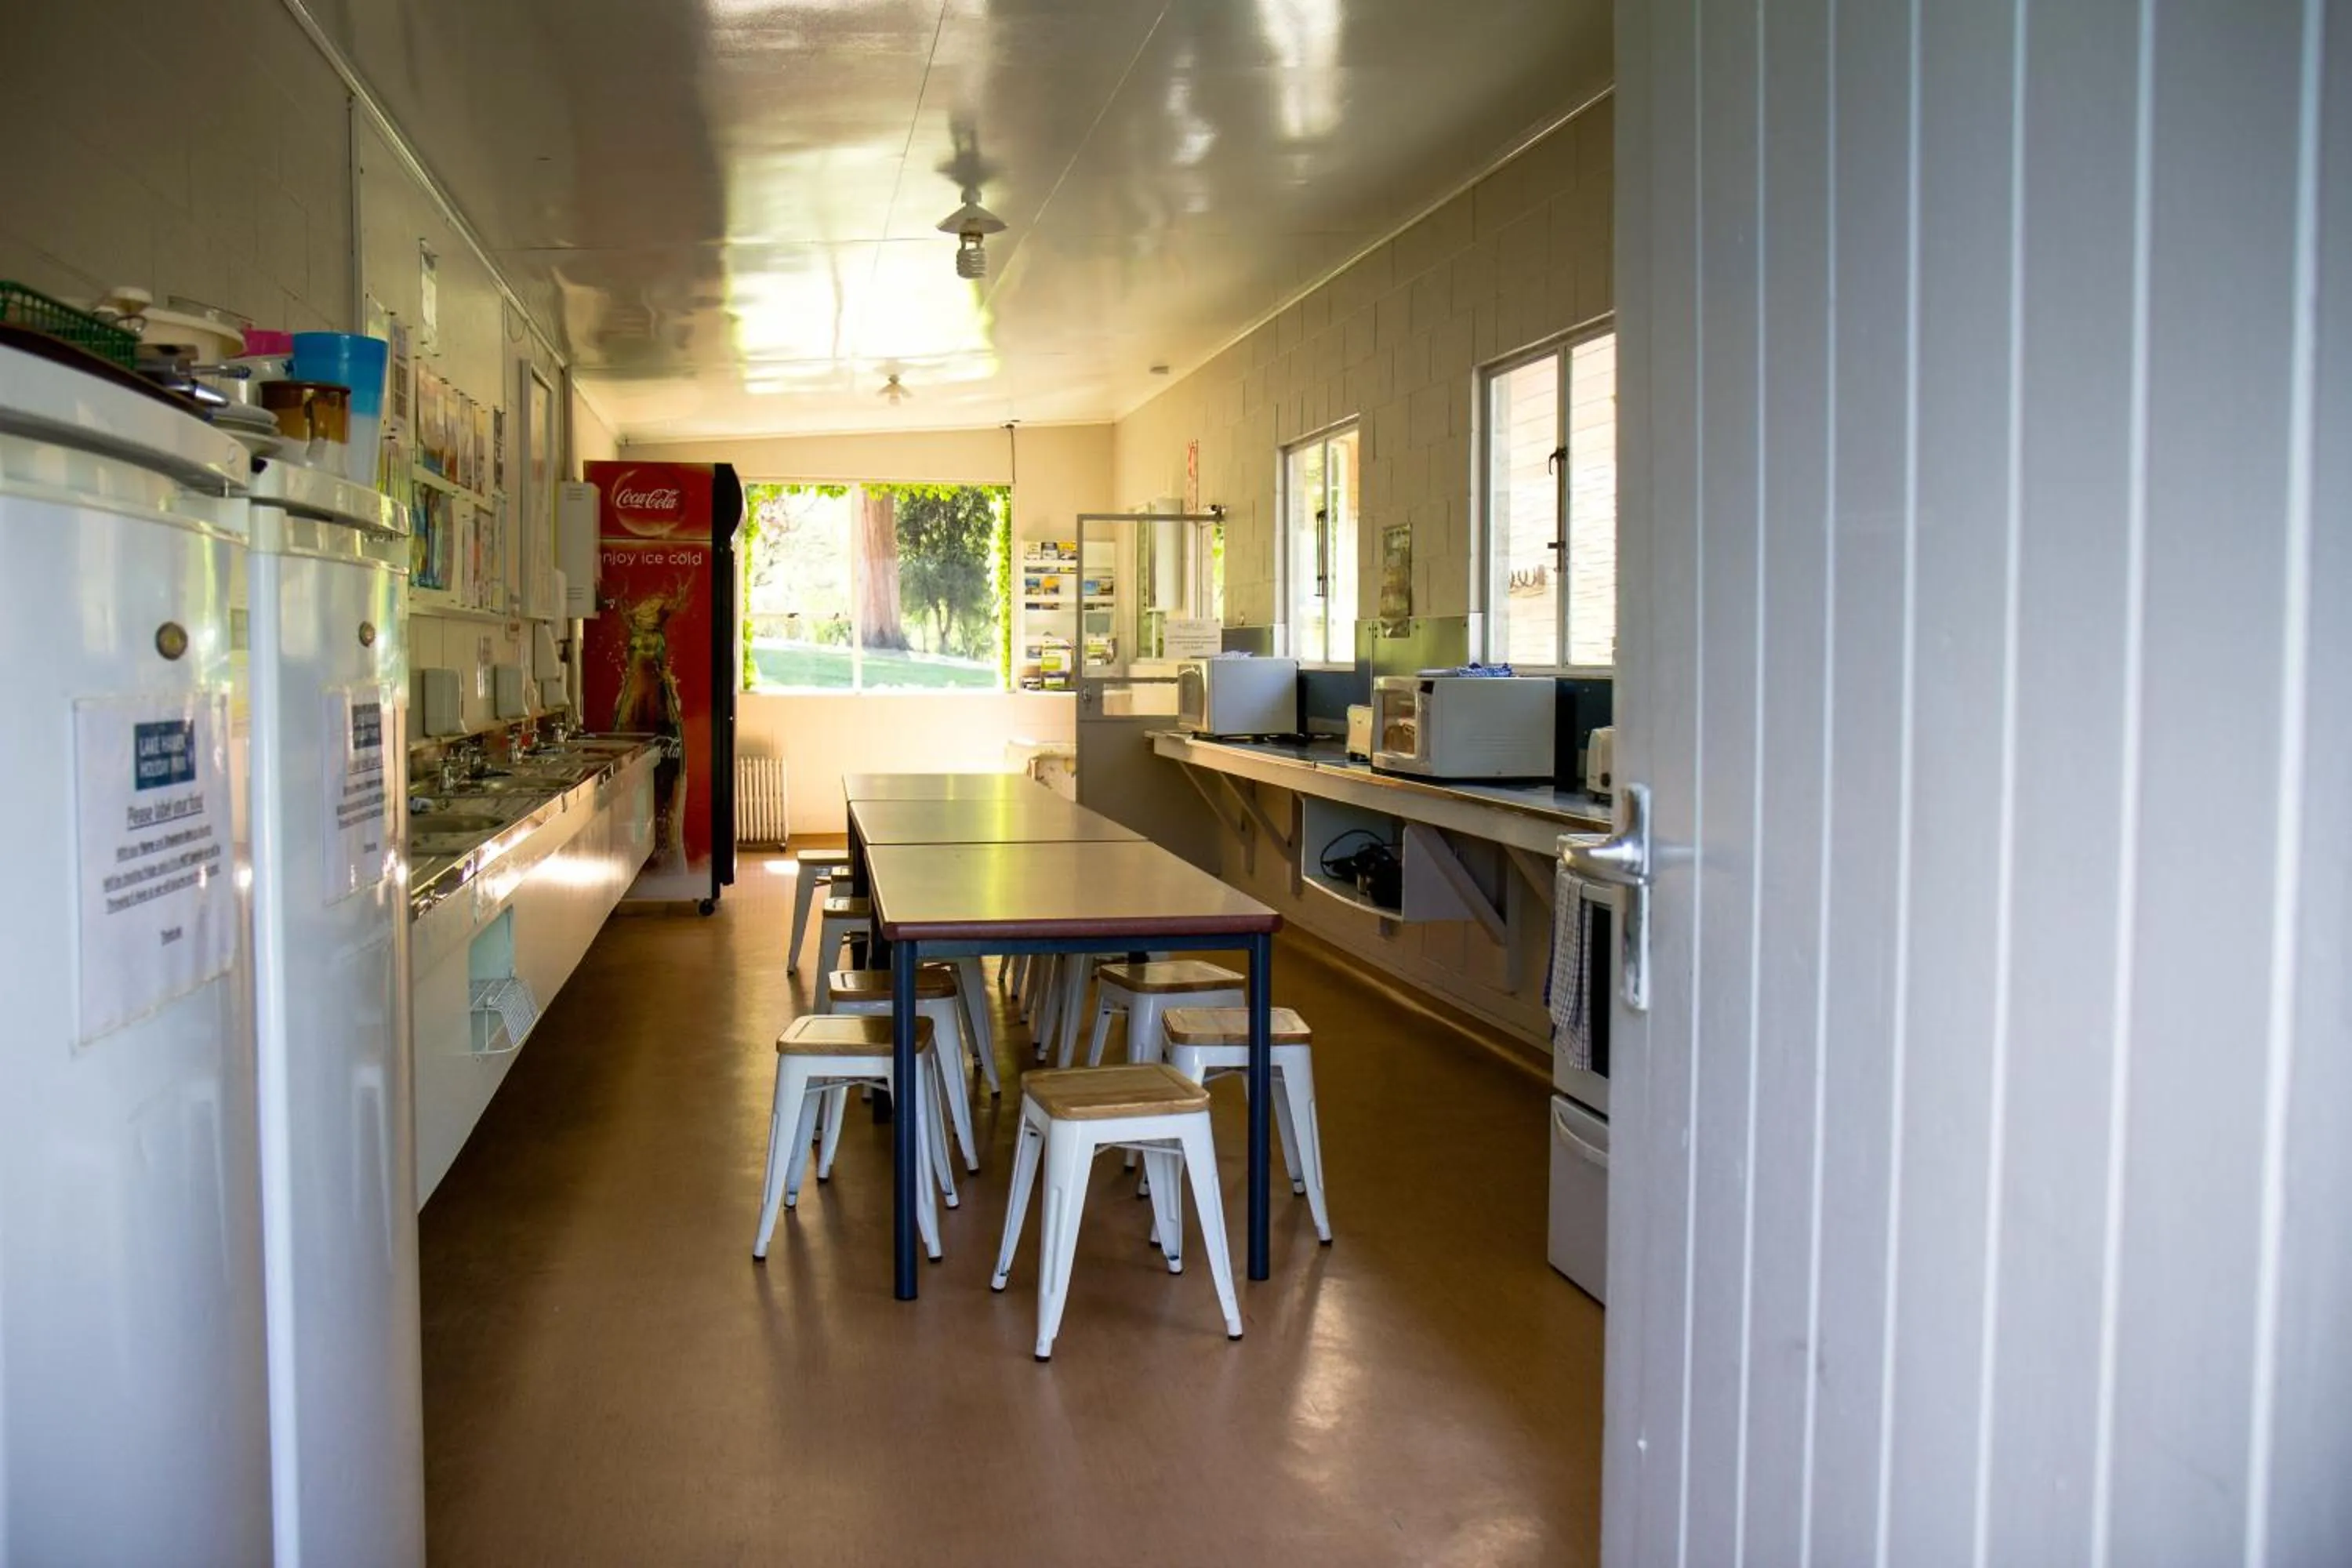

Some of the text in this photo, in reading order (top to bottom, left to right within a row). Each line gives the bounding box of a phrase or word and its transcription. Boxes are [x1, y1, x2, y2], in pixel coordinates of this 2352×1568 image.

[615, 488, 681, 510] Coca-Cola
[601, 550, 702, 567] njoy ice cold
